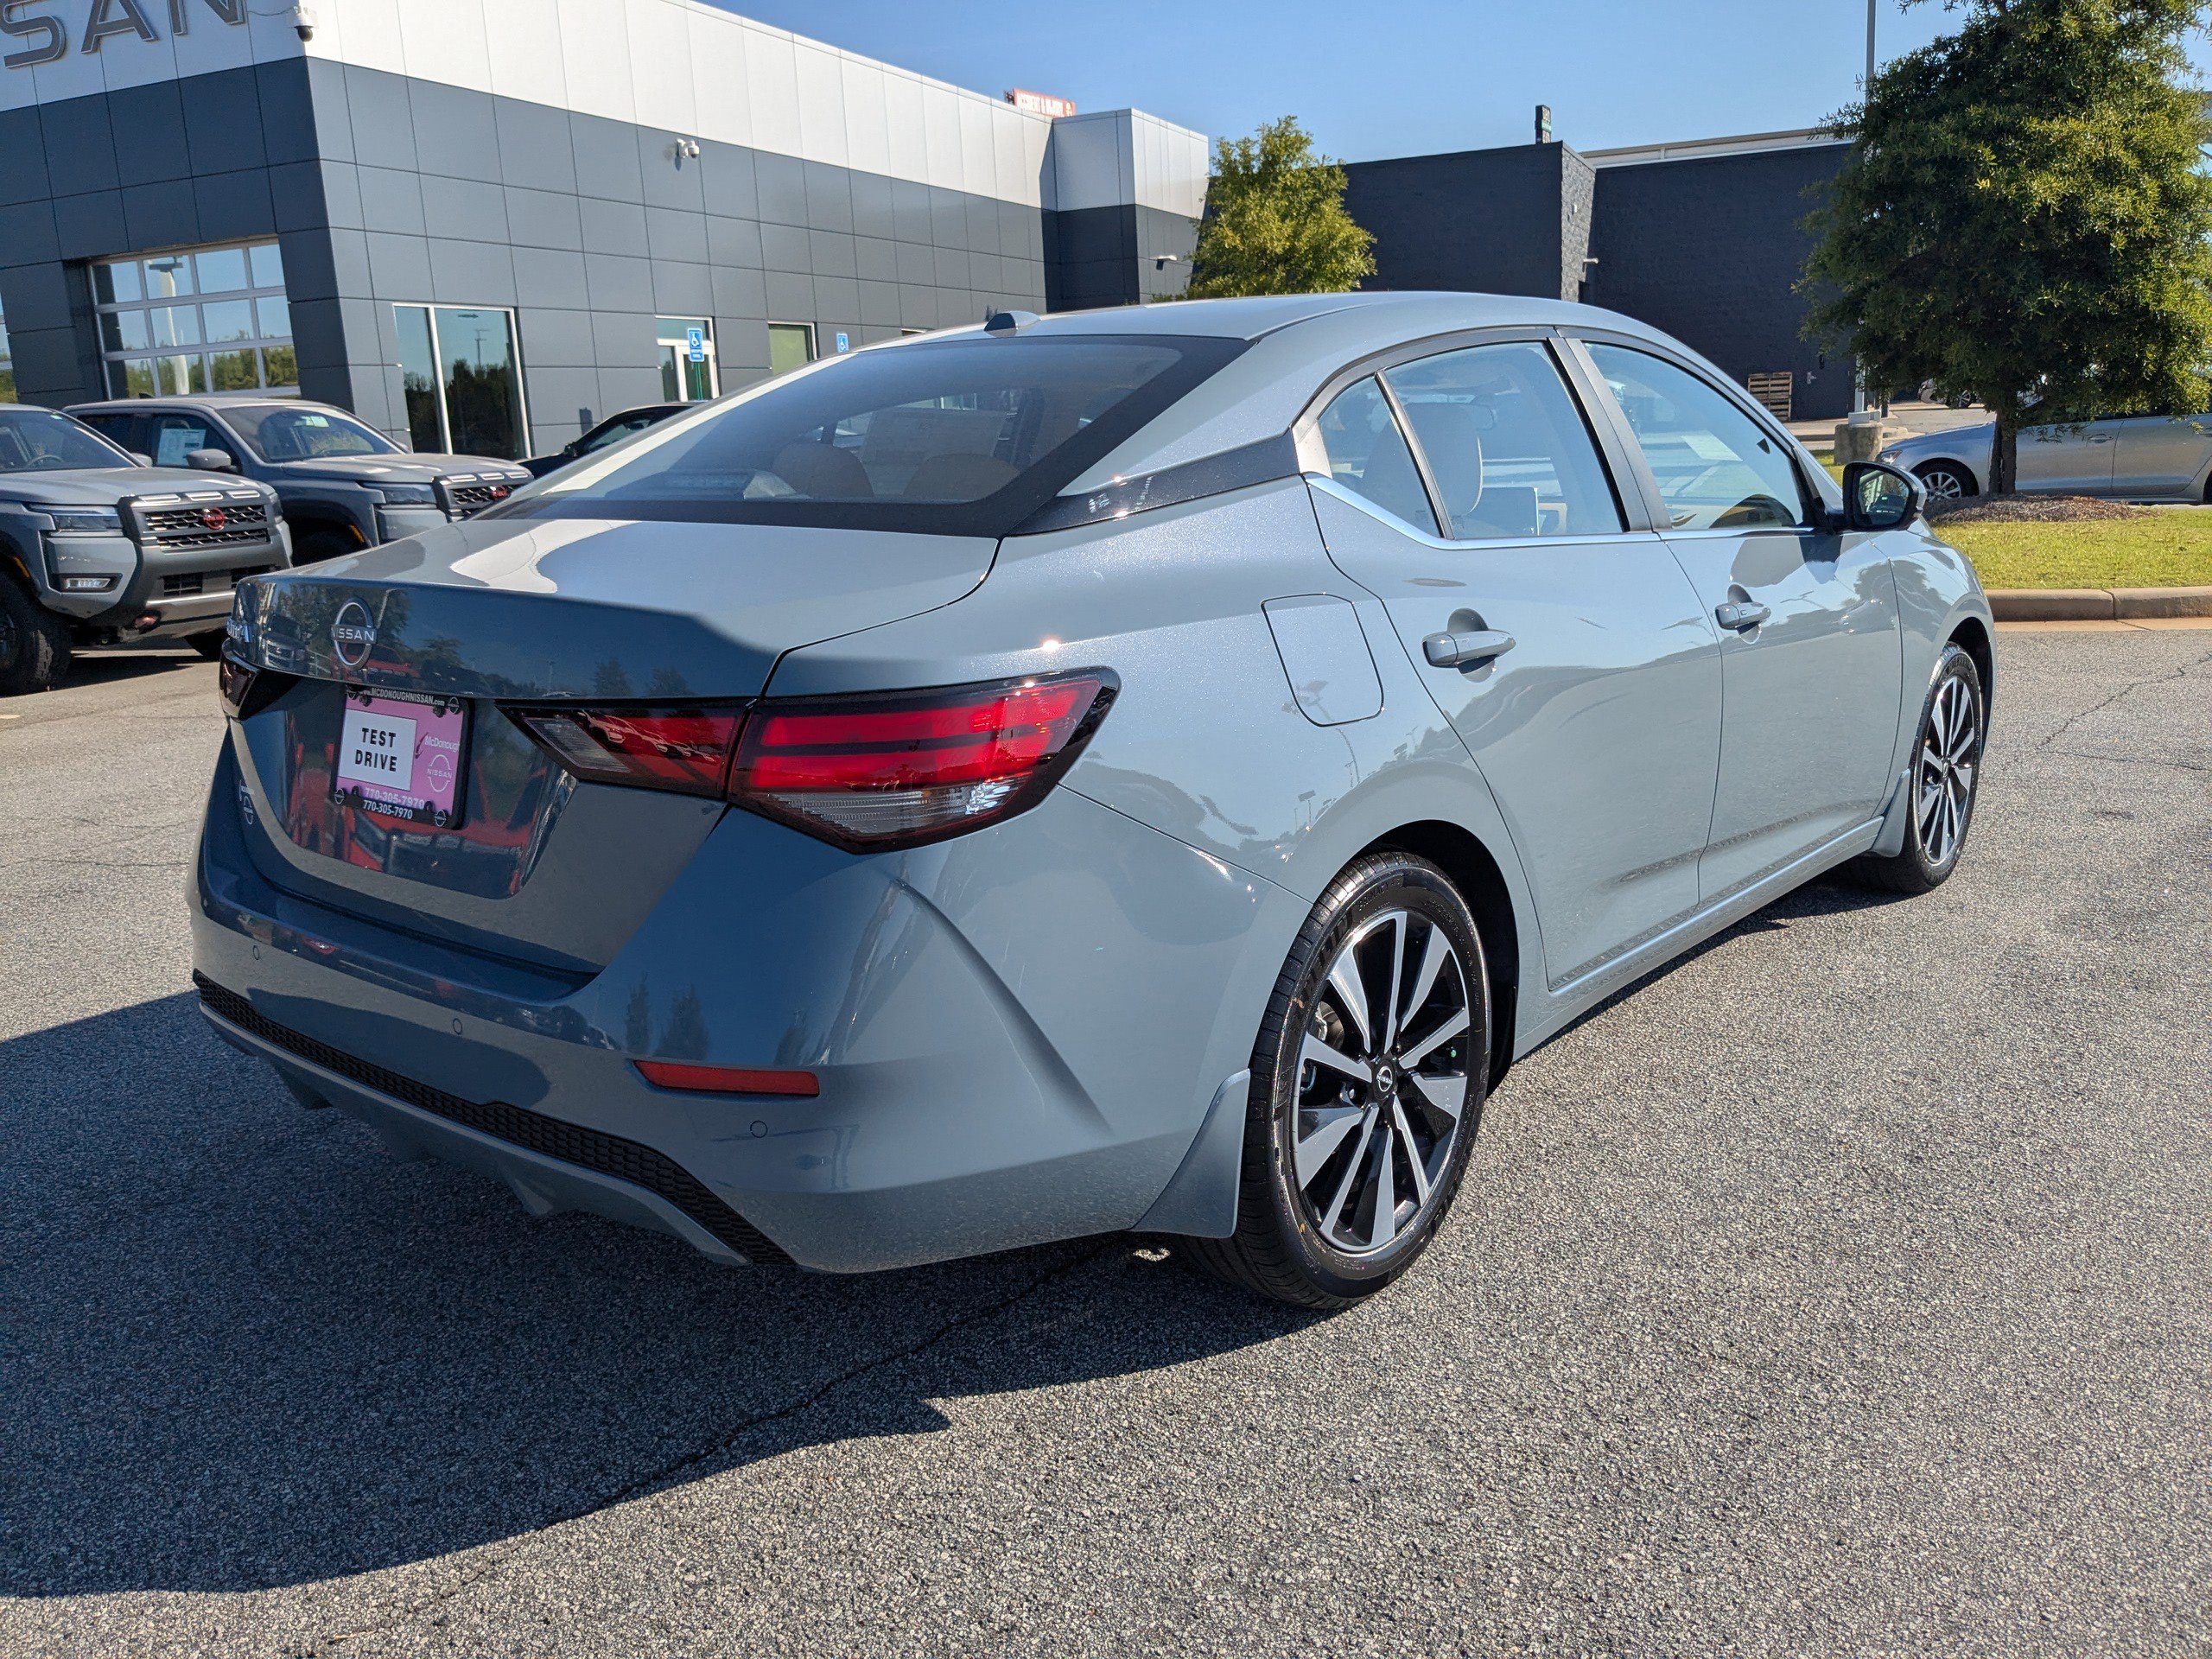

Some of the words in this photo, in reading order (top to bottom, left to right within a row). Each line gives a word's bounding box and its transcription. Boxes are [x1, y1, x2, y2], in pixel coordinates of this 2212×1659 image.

[331, 626, 375, 641] NISSAN
[361, 727, 397, 748] TEST
[354, 749, 397, 772] DRIVE
[365, 787, 425, 809] 770-305-7970
[363, 799, 413, 820] 770-305-7970
